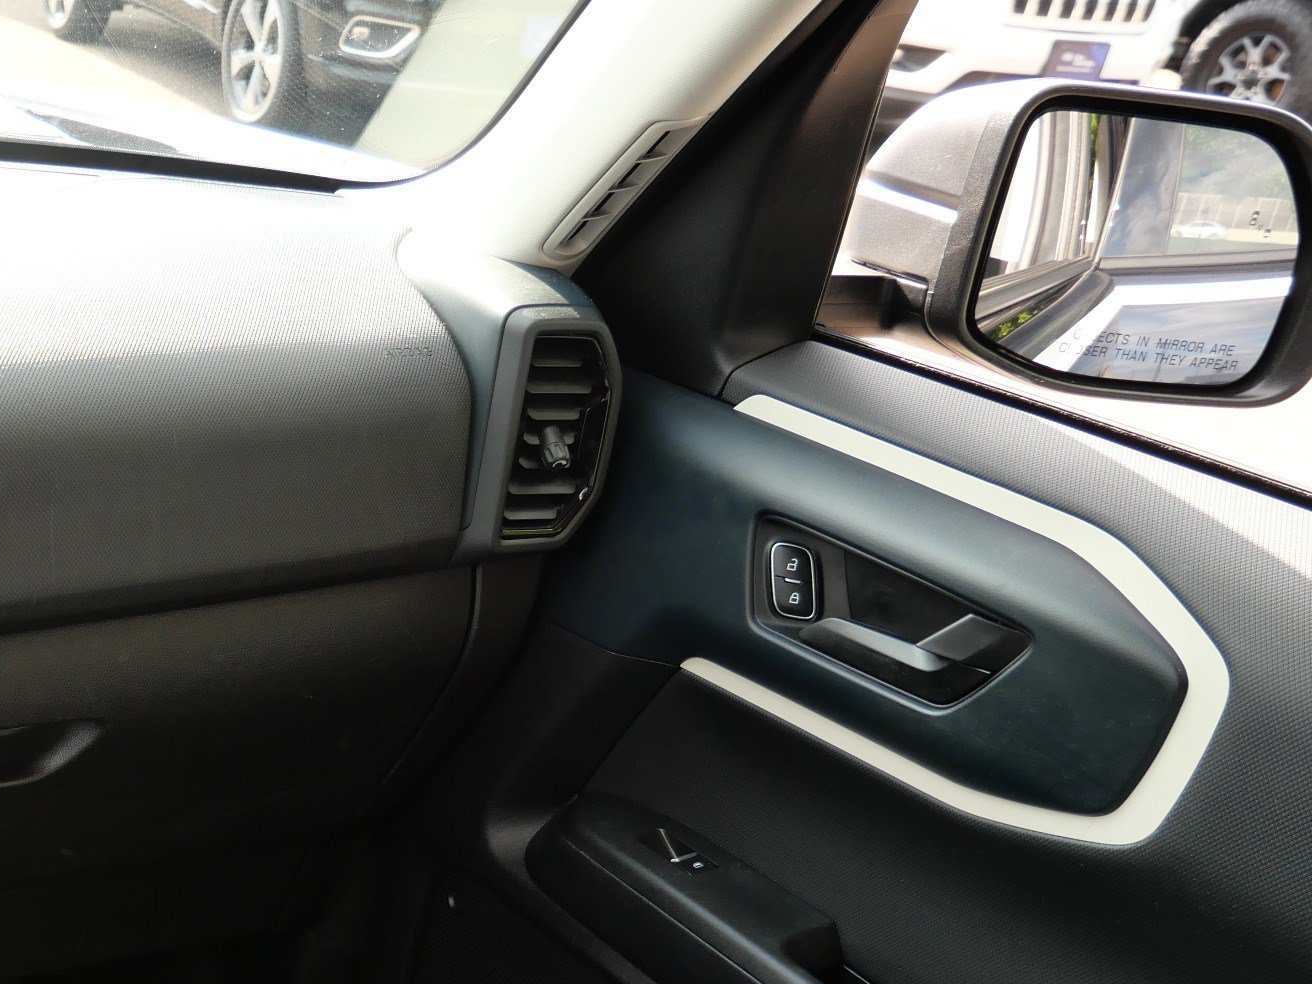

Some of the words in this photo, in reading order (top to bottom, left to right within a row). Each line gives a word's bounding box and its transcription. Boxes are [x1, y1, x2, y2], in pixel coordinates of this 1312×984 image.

[1136, 336, 1150, 347] IN
[1155, 338, 1204, 353] MIRROR
[1209, 344, 1236, 356] ARE
[1114, 348, 1147, 362] THAN
[1154, 353, 1186, 366] THEY
[1189, 357, 1238, 371] APPEAR
